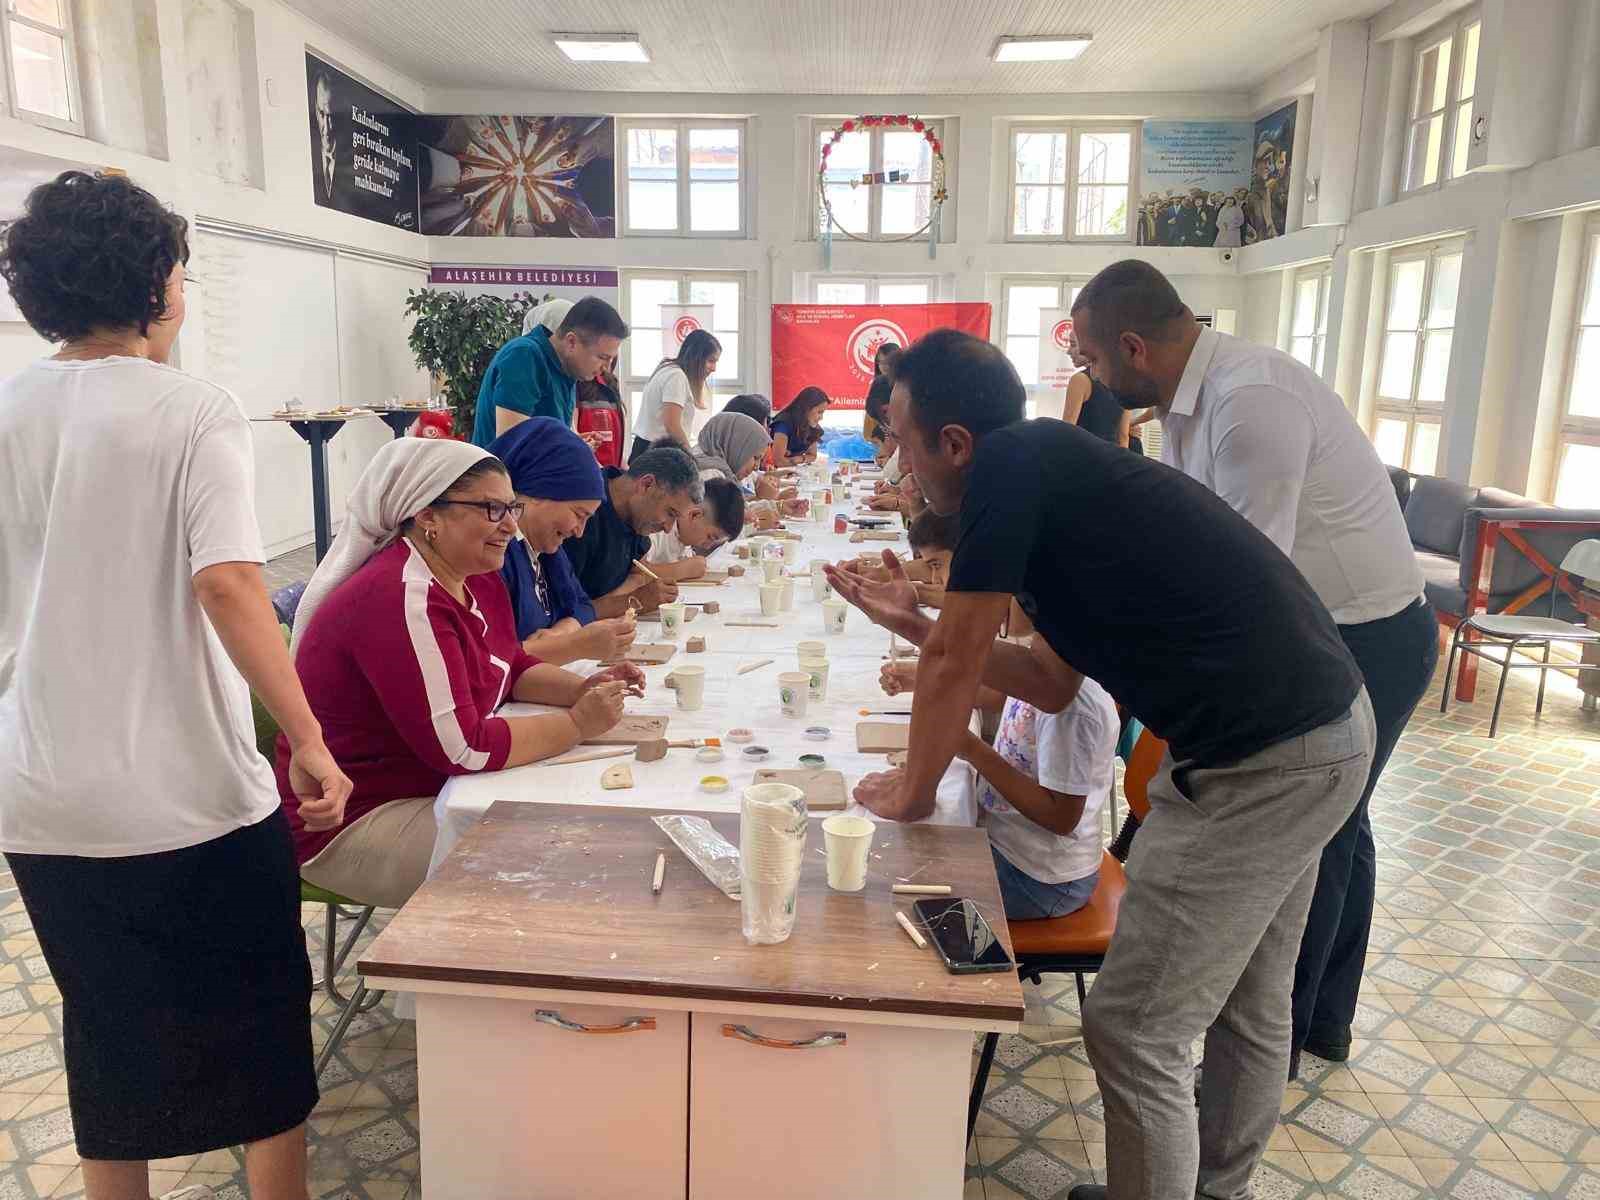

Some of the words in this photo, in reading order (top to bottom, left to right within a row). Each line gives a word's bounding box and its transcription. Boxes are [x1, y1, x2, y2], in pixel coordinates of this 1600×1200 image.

[352, 131, 366, 148] geri
[366, 132, 391, 158] bırakan
[353, 154, 374, 170] geride
[374, 157, 400, 184] kalmaya
[354, 174, 393, 198] mahkumdur
[446, 271, 512, 283] ALAŞEHİR
[517, 271, 597, 284] BELEDİYESİ
